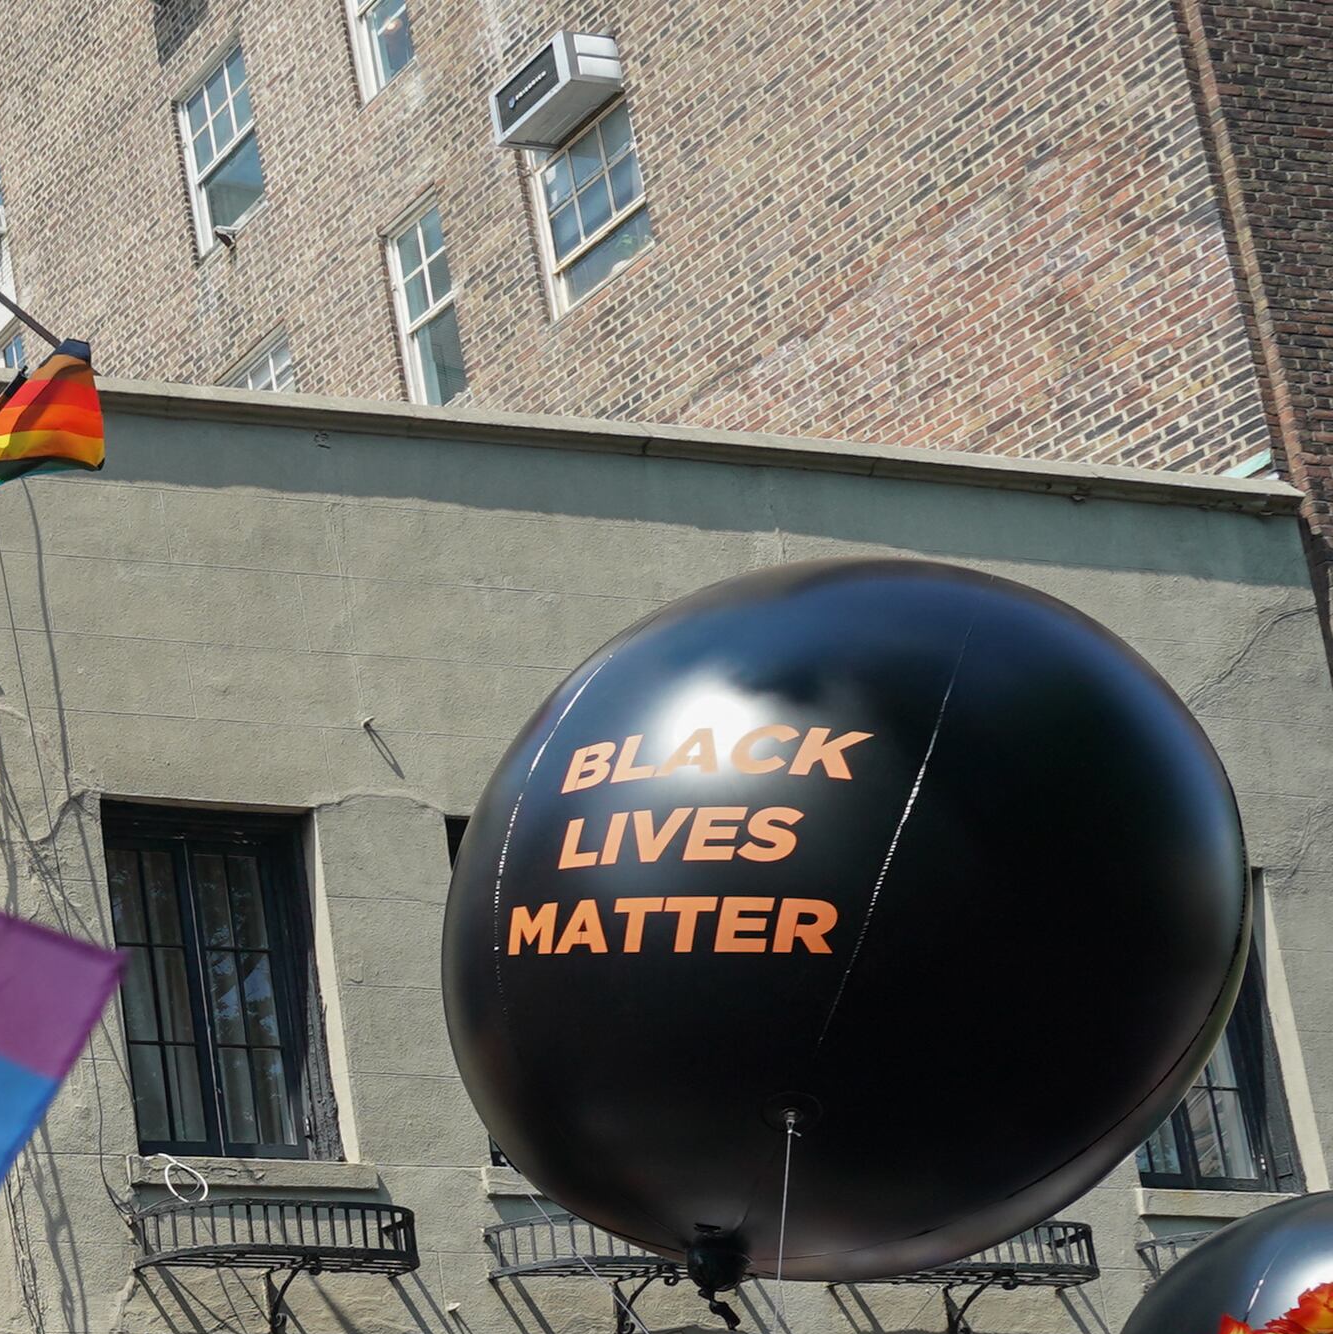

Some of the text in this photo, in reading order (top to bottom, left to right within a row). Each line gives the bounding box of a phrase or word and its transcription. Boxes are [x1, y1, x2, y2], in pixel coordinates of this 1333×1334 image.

[560, 724, 875, 794] BLACK
[558, 806, 805, 870] LIVES
[507, 896, 839, 956] MATTER
